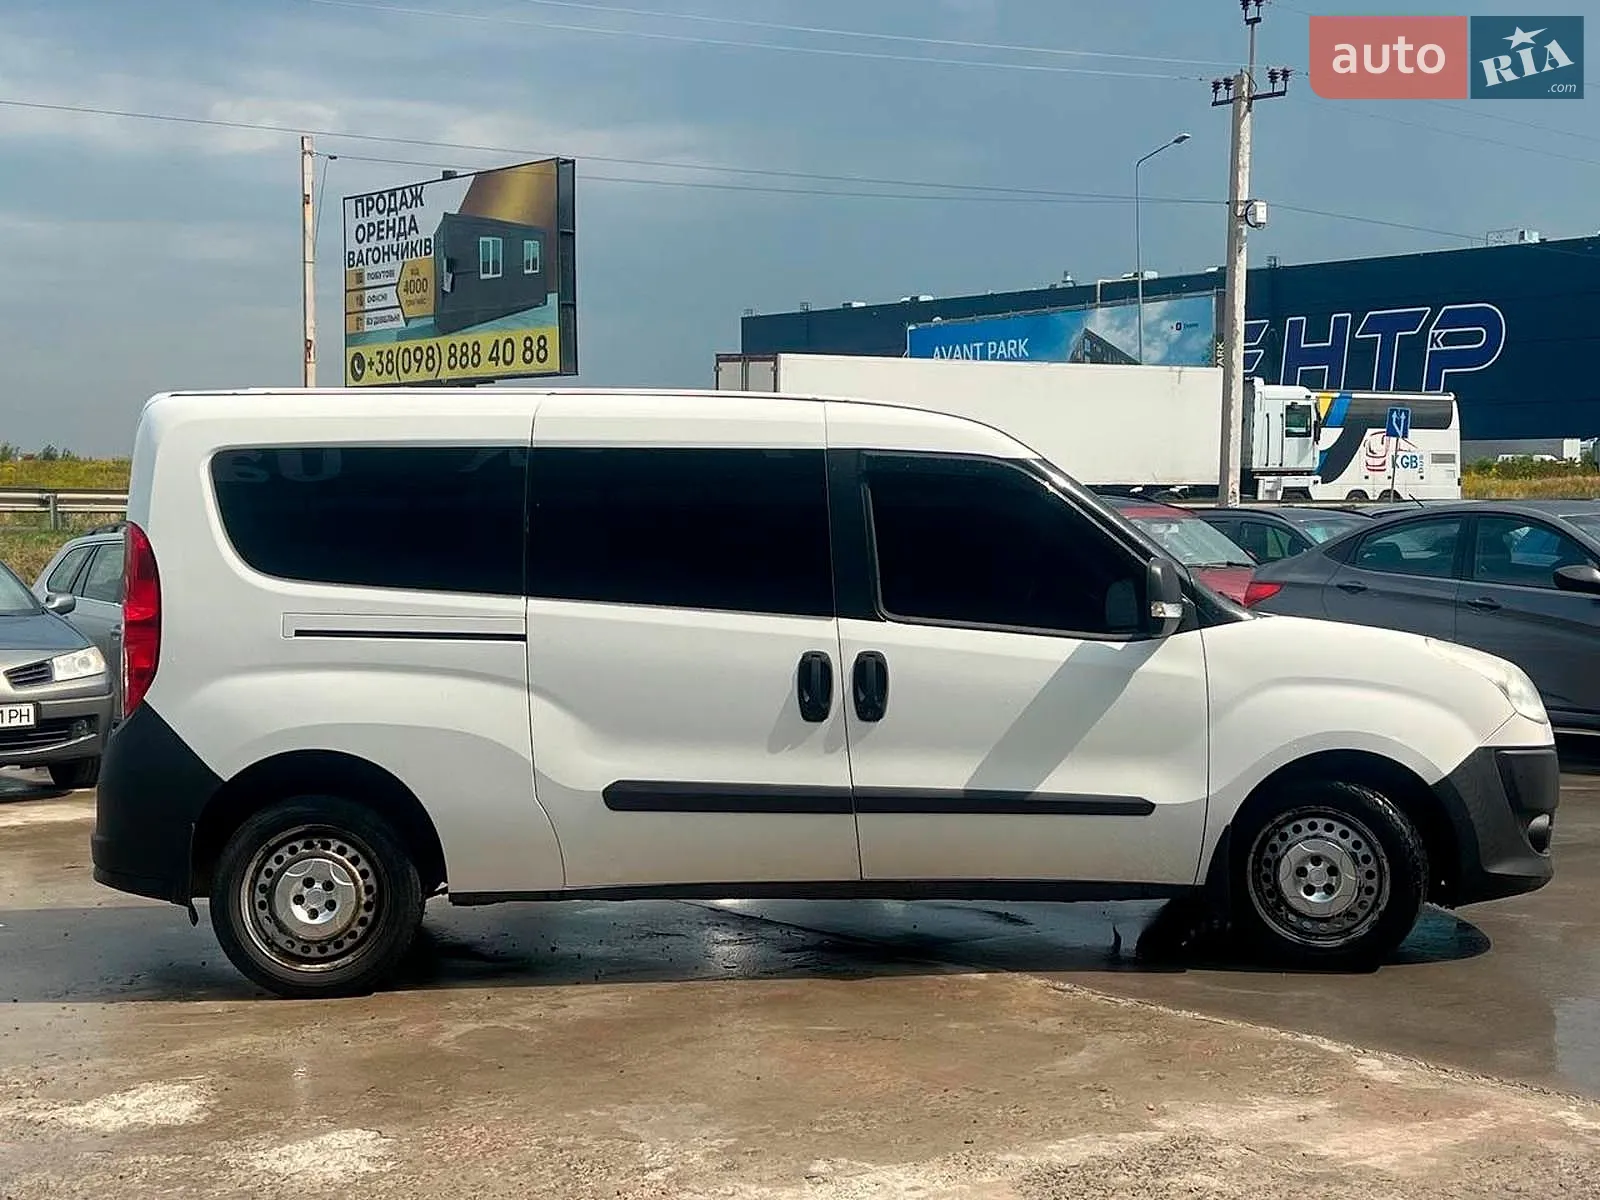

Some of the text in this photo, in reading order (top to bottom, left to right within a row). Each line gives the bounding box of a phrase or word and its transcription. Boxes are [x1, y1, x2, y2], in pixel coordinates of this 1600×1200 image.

[354, 185, 425, 219] ПРОДАЖ
[355, 214, 419, 245] ОРЕНДА
[347, 237, 433, 269] ВАГОНЧИКІВ
[403, 278, 428, 295] 4000
[367, 334, 549, 380] +38(098) 888 40 88
[933, 337, 1030, 361] AVANT PARK
[1216, 341, 1225, 367] ARK
[1391, 454, 1418, 469] KGB
